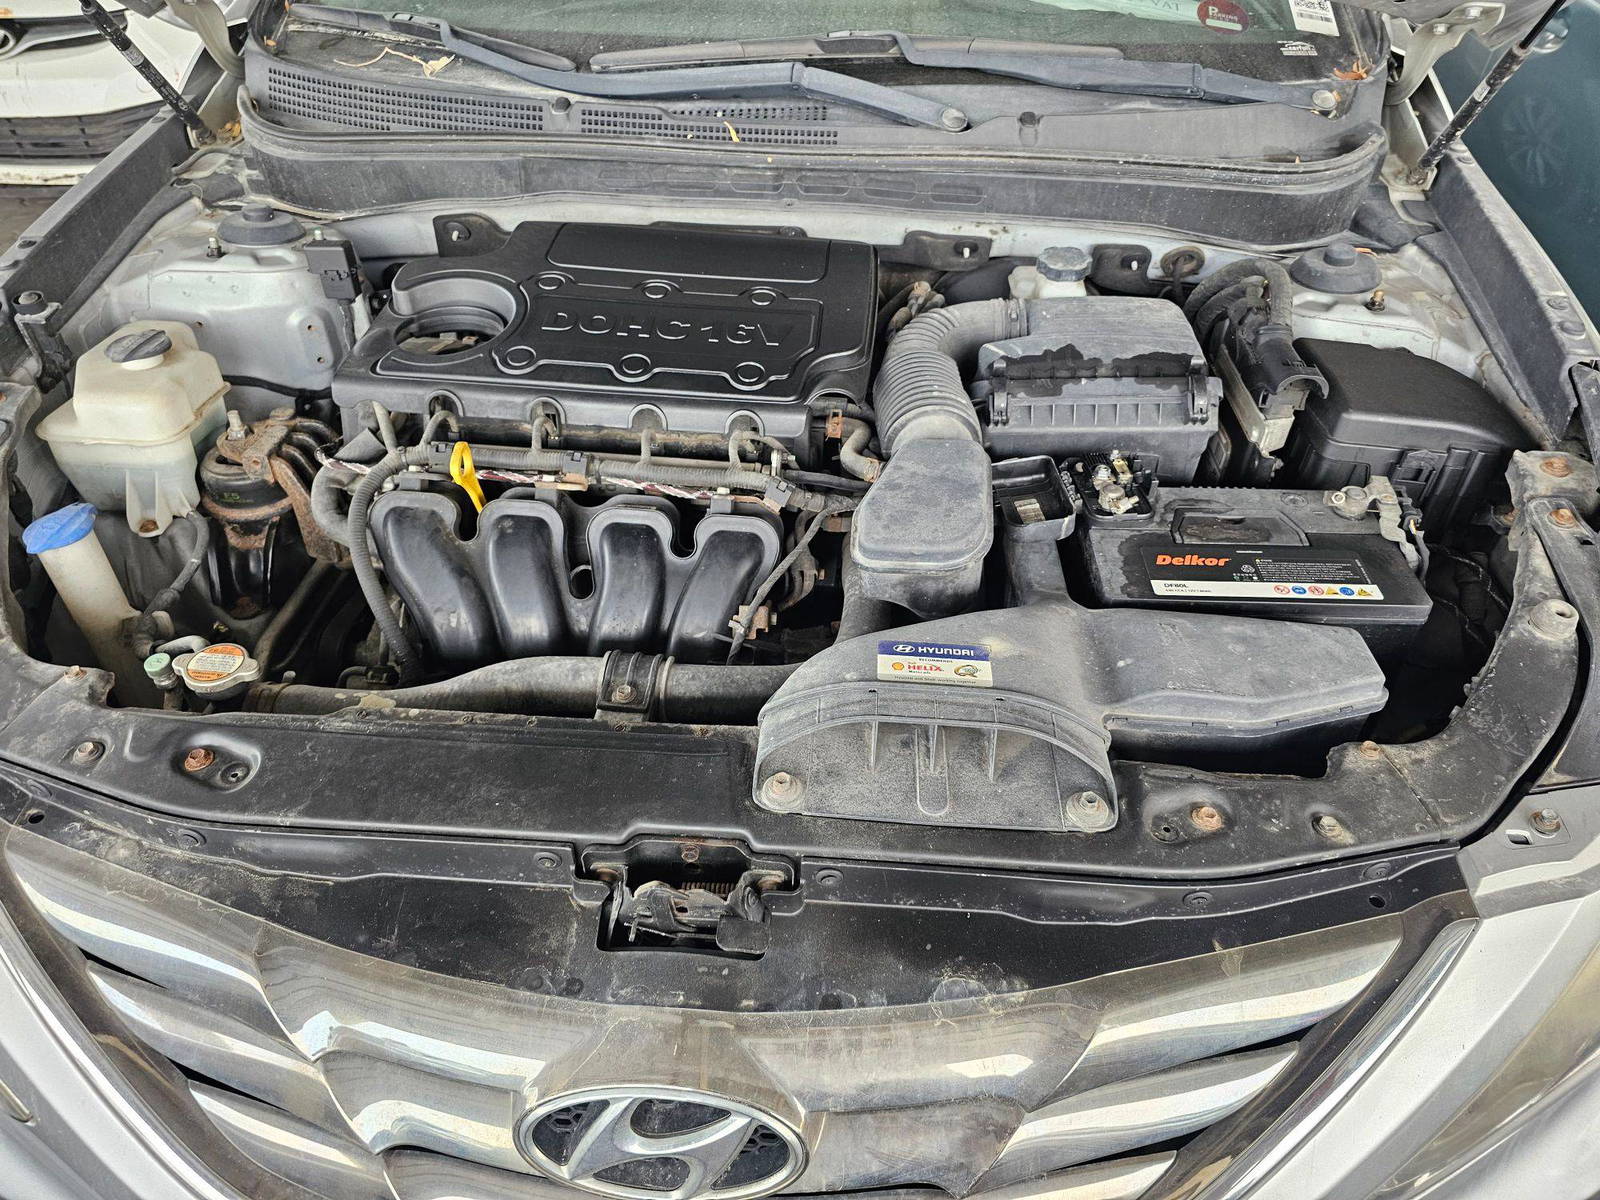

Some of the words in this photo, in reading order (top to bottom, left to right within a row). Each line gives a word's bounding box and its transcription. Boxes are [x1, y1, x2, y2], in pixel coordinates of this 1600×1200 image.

[541, 309, 693, 341] DOHC
[700, 321, 794, 347] 16V
[1155, 554, 1231, 567] Delkor
[917, 645, 975, 657] HYUNDAI
[907, 664, 943, 672] HELIX
